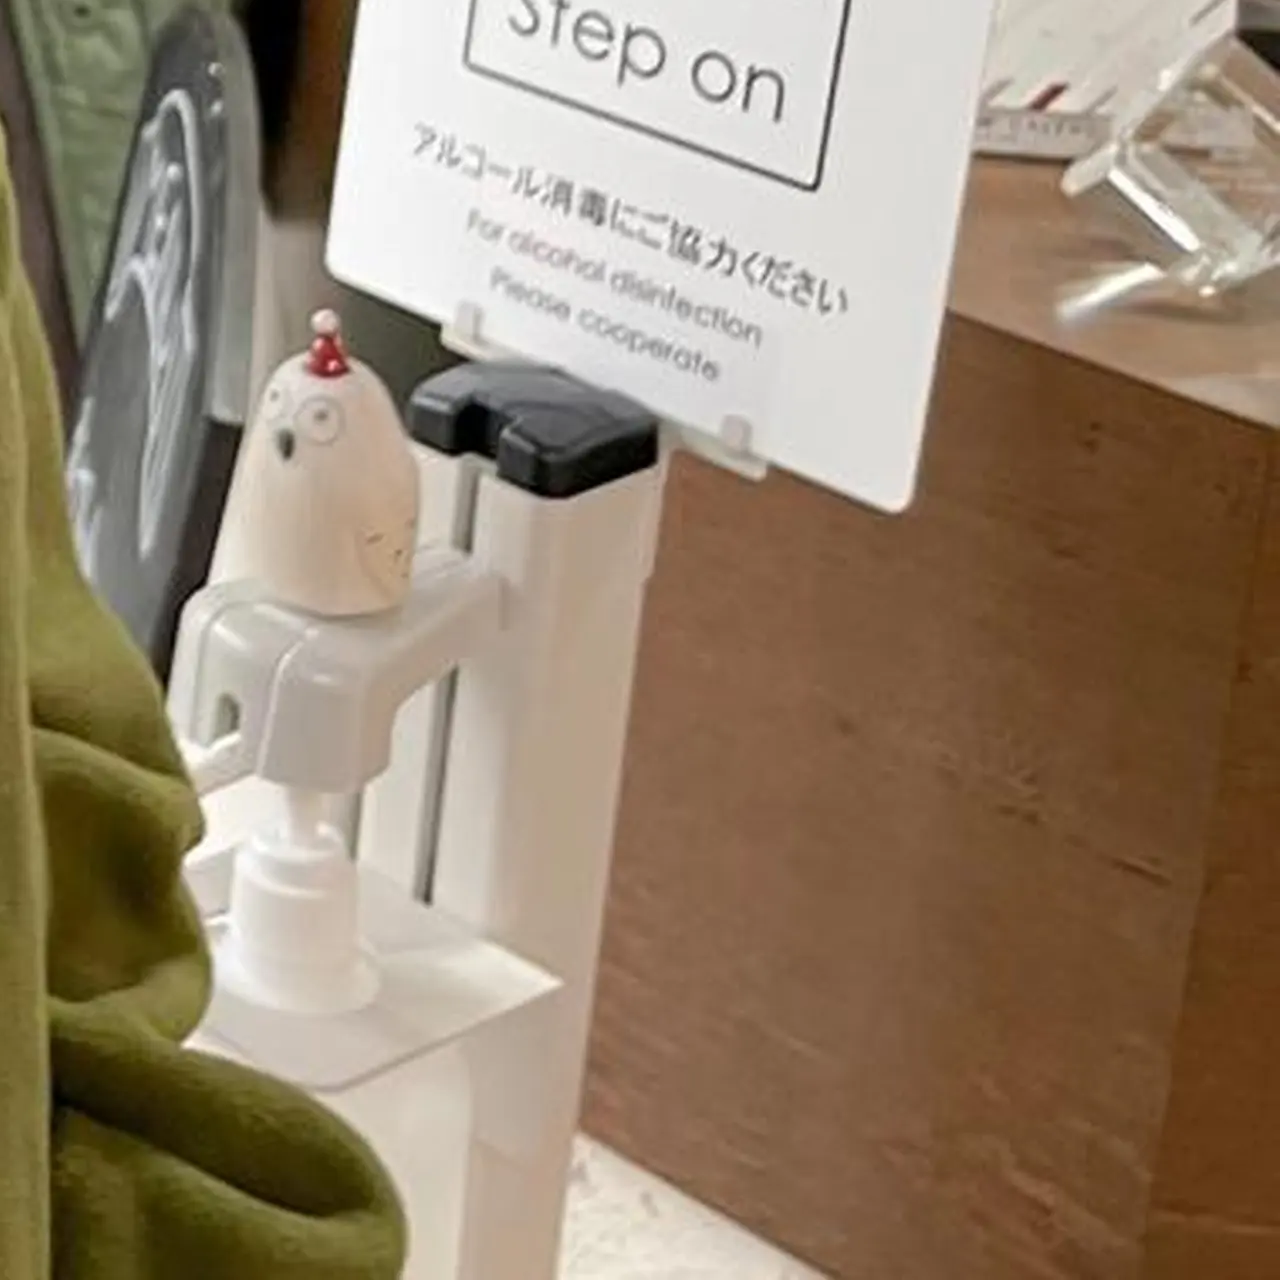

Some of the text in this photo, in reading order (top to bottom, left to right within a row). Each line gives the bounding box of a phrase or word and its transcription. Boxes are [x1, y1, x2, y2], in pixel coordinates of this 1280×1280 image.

[690, 49, 785, 124] on
[412, 121, 849, 316] アルコール消毒にご協力ください
[467, 207, 763, 350] For alcohol disinfection
[490, 265, 721, 382] Please cooperate
